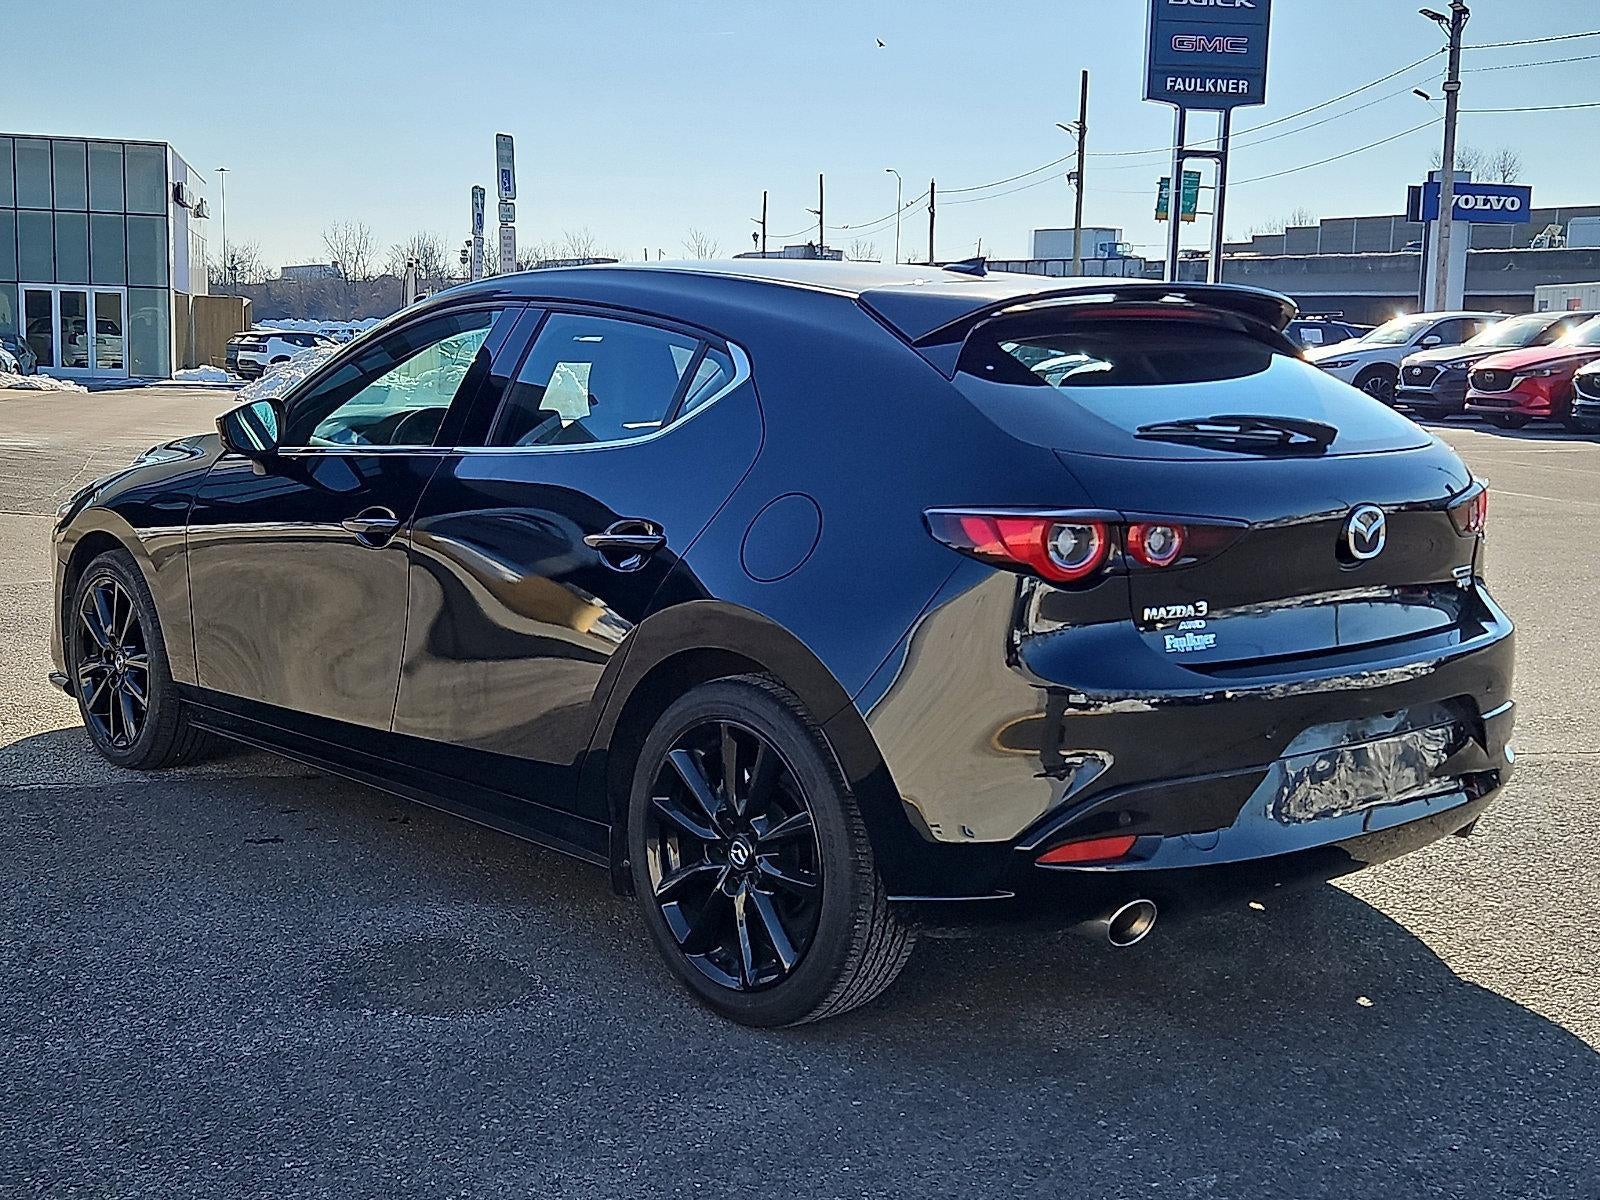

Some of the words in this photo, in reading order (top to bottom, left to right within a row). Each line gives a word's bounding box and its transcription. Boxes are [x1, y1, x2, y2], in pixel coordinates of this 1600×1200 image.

[1172, 35, 1249, 53] GMC
[1166, 77, 1249, 94] FAULKNER
[1164, 633, 1216, 650] Faulkner
